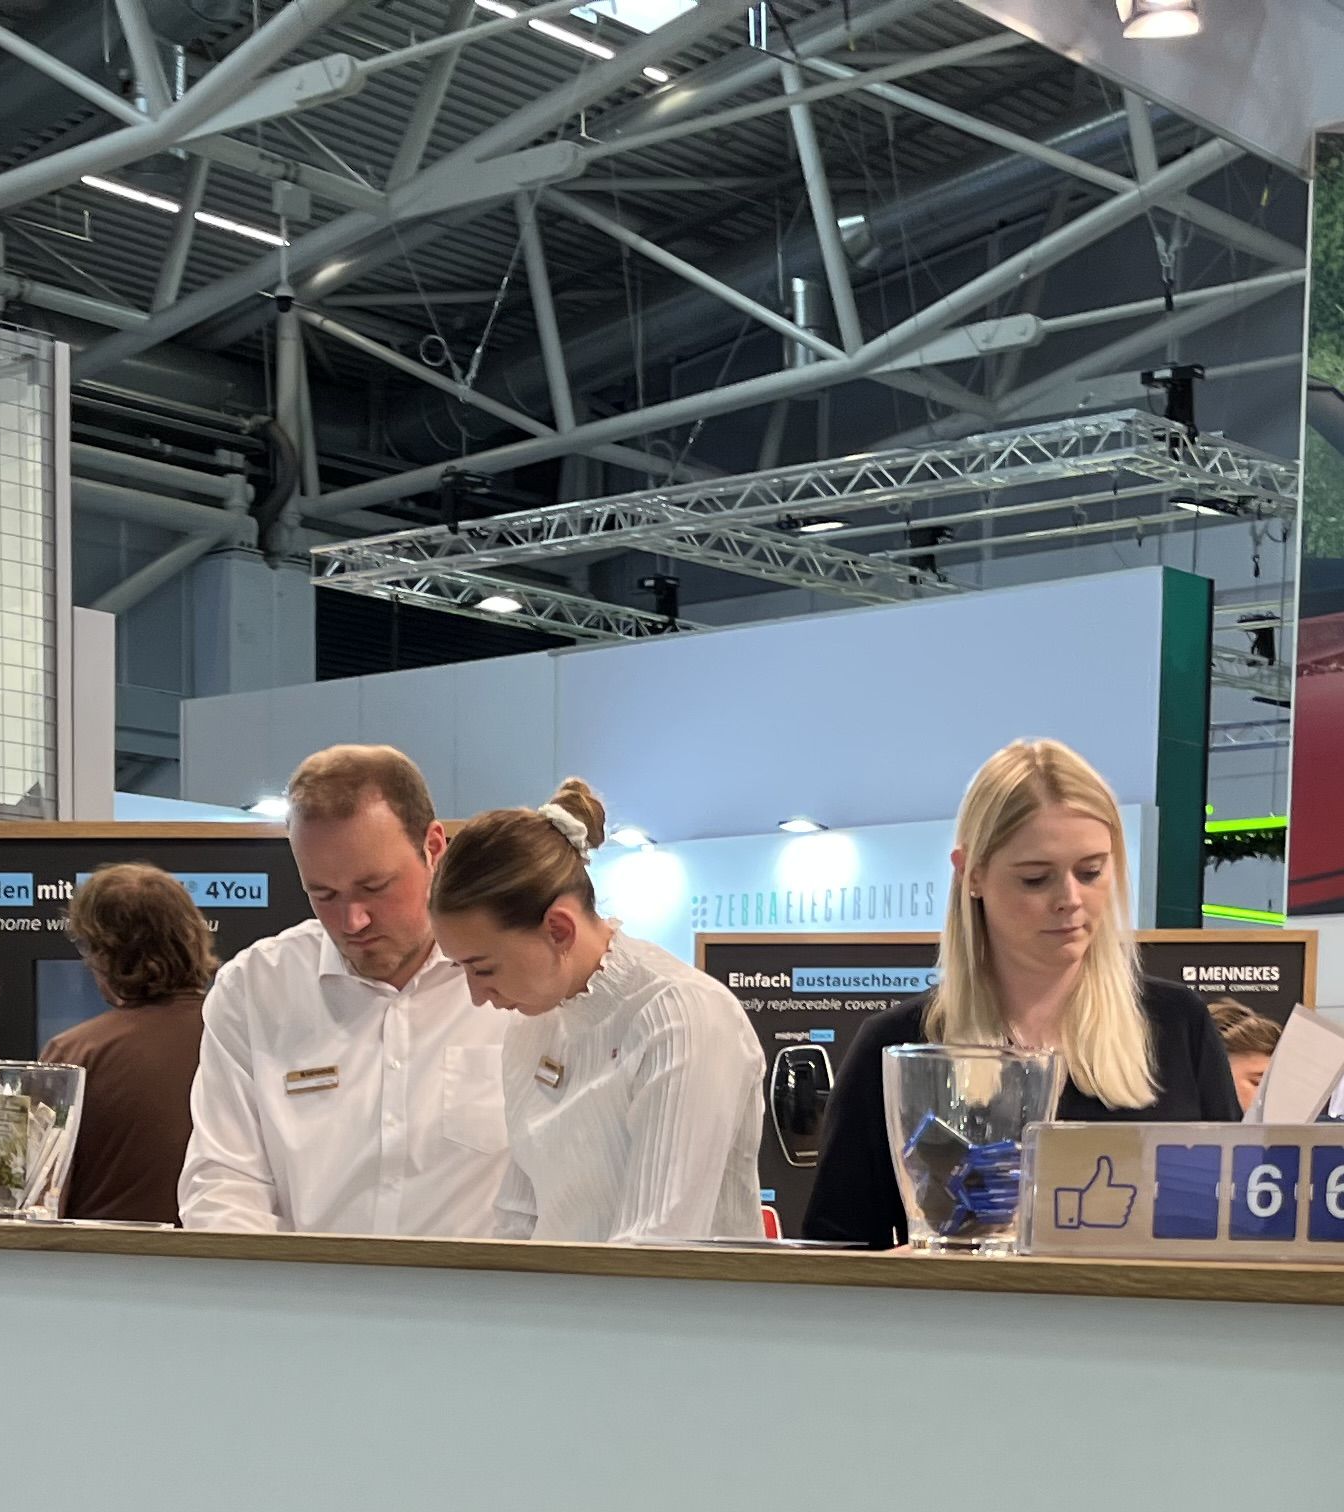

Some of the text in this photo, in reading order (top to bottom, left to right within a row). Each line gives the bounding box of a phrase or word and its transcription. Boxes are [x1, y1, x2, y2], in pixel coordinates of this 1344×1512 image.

[37, 879, 74, 900] mit
[205, 881, 262, 900] 4You
[728, 972, 791, 988] Einfach
[796, 972, 920, 987] austauschbare
[1199, 966, 1280, 981] MENNEKES
[767, 998, 842, 1012] replaceable
[844, 1000, 887, 1011] covers
